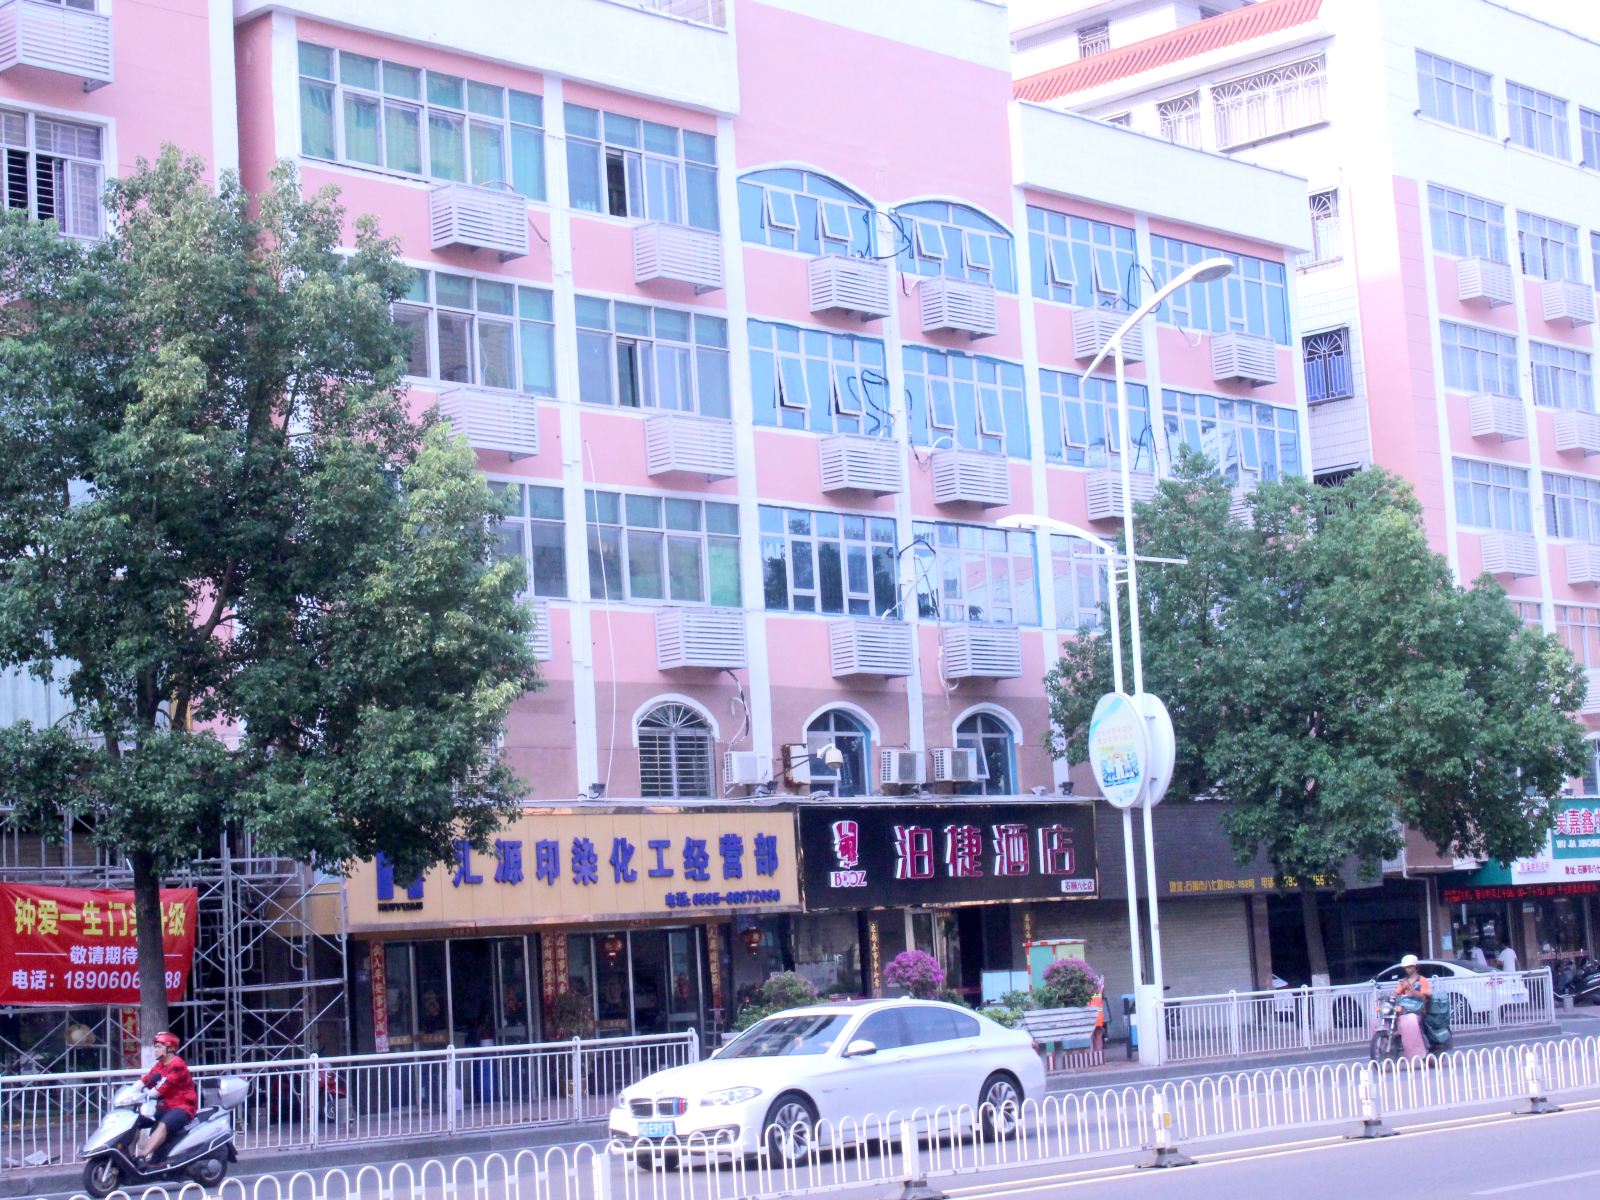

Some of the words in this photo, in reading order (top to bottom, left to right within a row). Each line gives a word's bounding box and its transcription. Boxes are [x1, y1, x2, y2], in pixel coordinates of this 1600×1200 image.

[452, 832, 780, 888] 汇源印染化工经营部
[893, 823, 1076, 880] 泊捷酒店
[15, 897, 186, 937] 钟爱一生门级
[69, 946, 138, 965] 敬请期待
[12, 970, 181, 990] 电话:189060688
